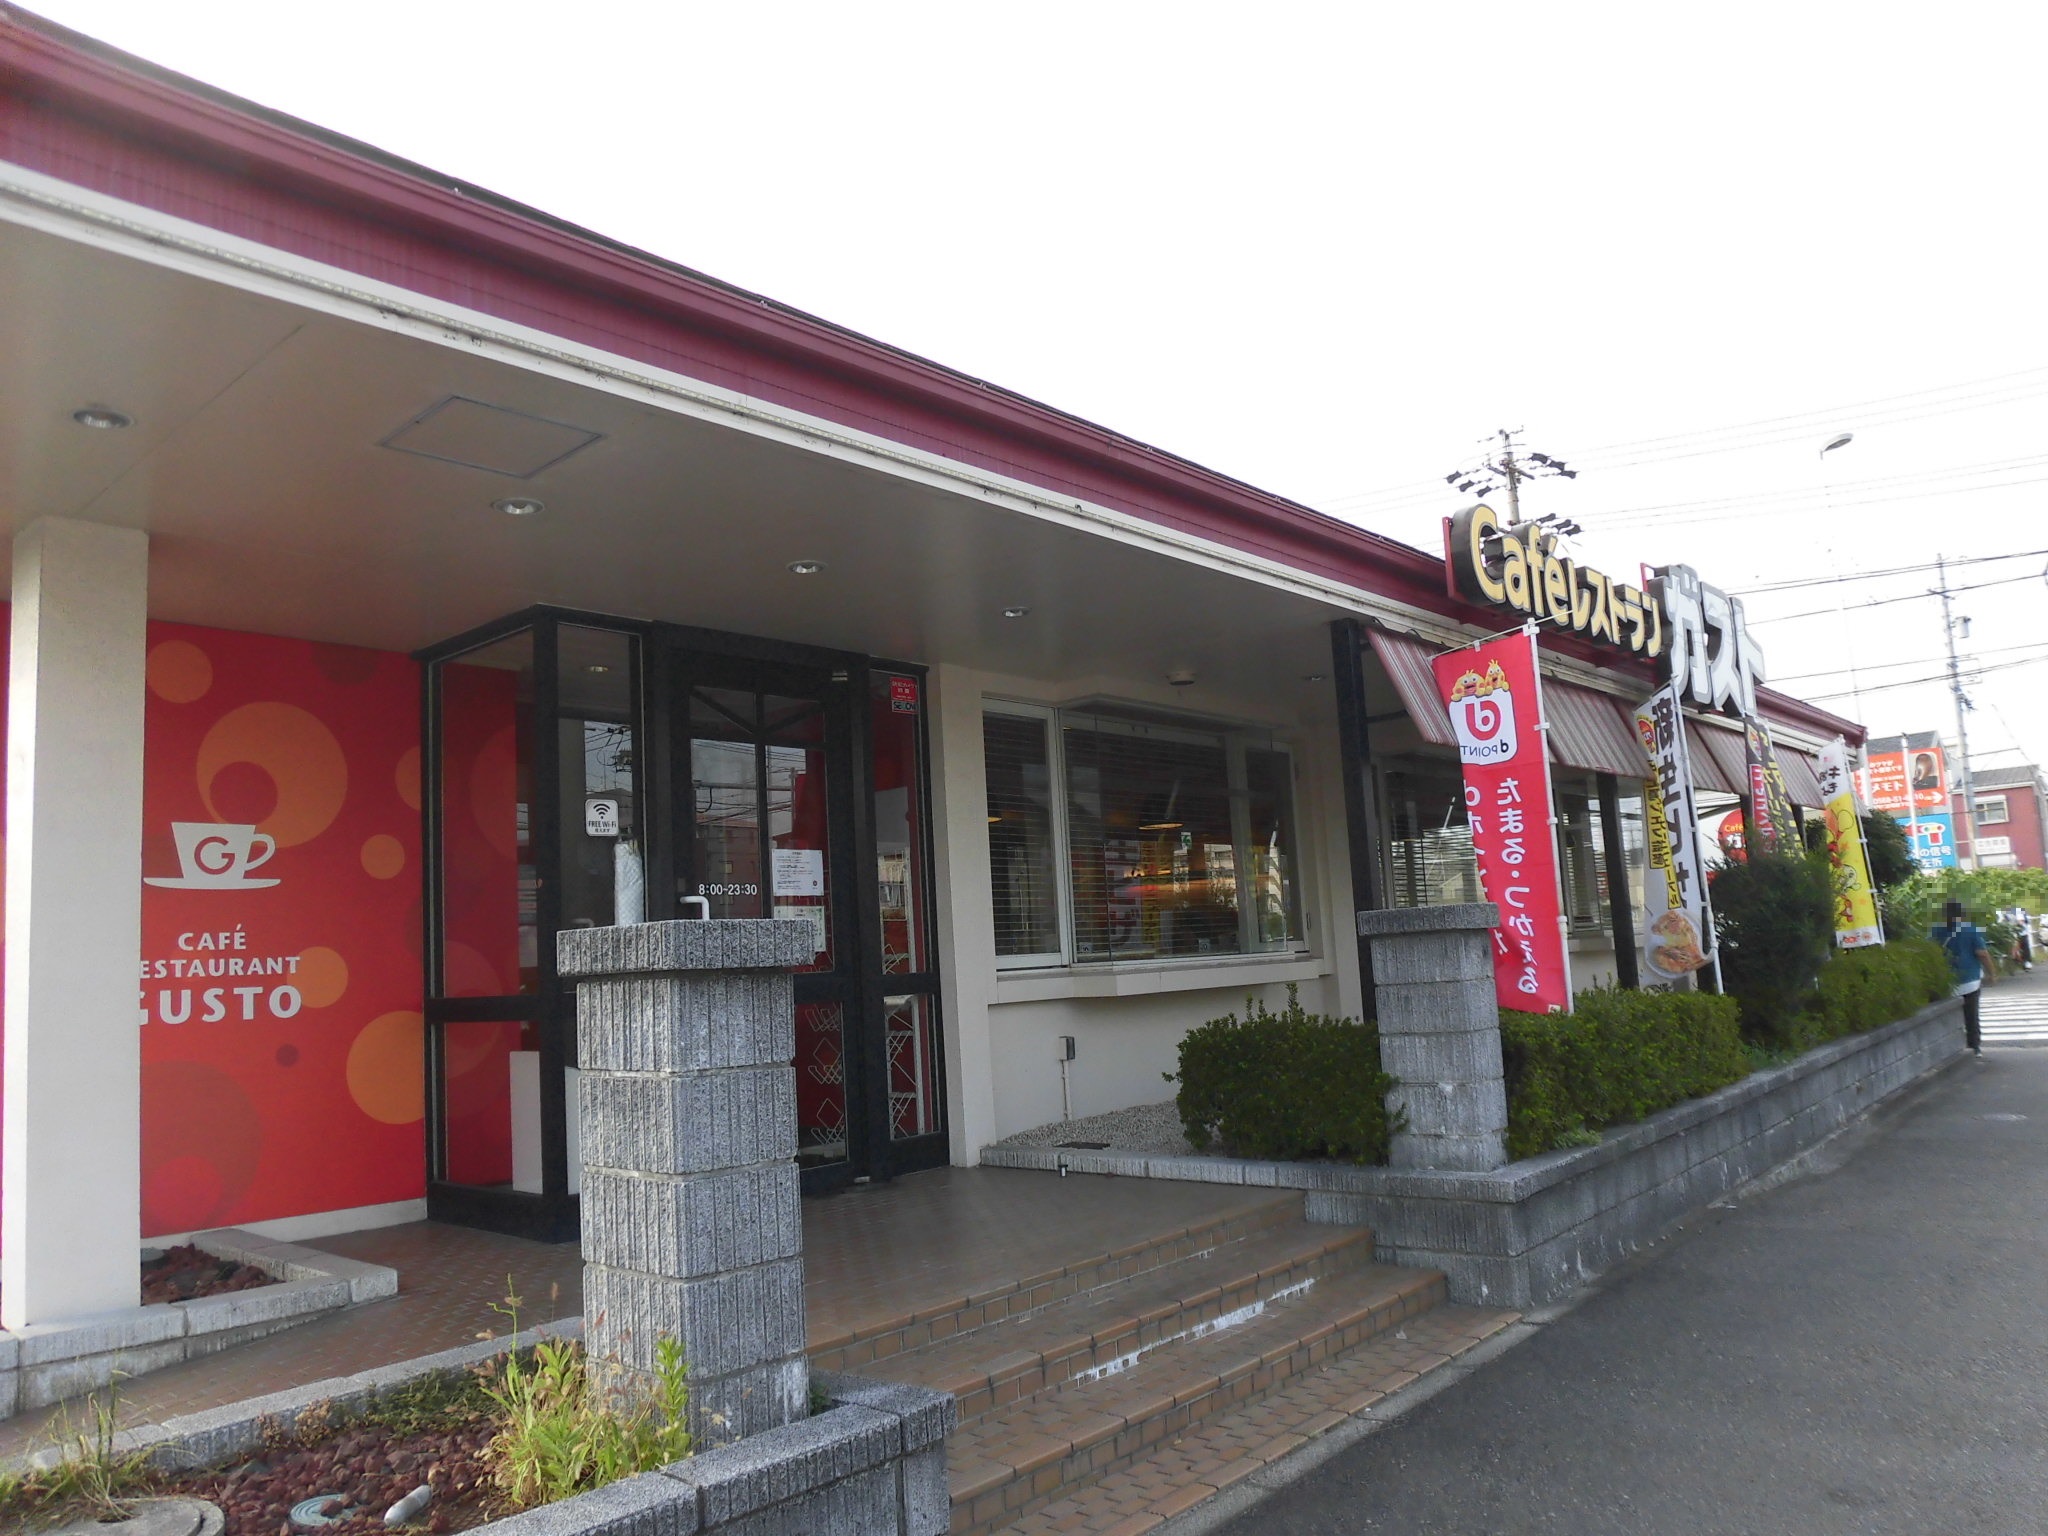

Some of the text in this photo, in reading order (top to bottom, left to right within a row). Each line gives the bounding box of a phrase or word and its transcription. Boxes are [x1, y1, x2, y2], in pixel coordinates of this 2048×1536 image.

[1658, 562, 1766, 722] ガスト
[588, 820, 602, 828] FREE
[193, 836, 236, 875] G
[178, 923, 247, 951] CAFÉ
[140, 956, 301, 979] ESTAURANT
